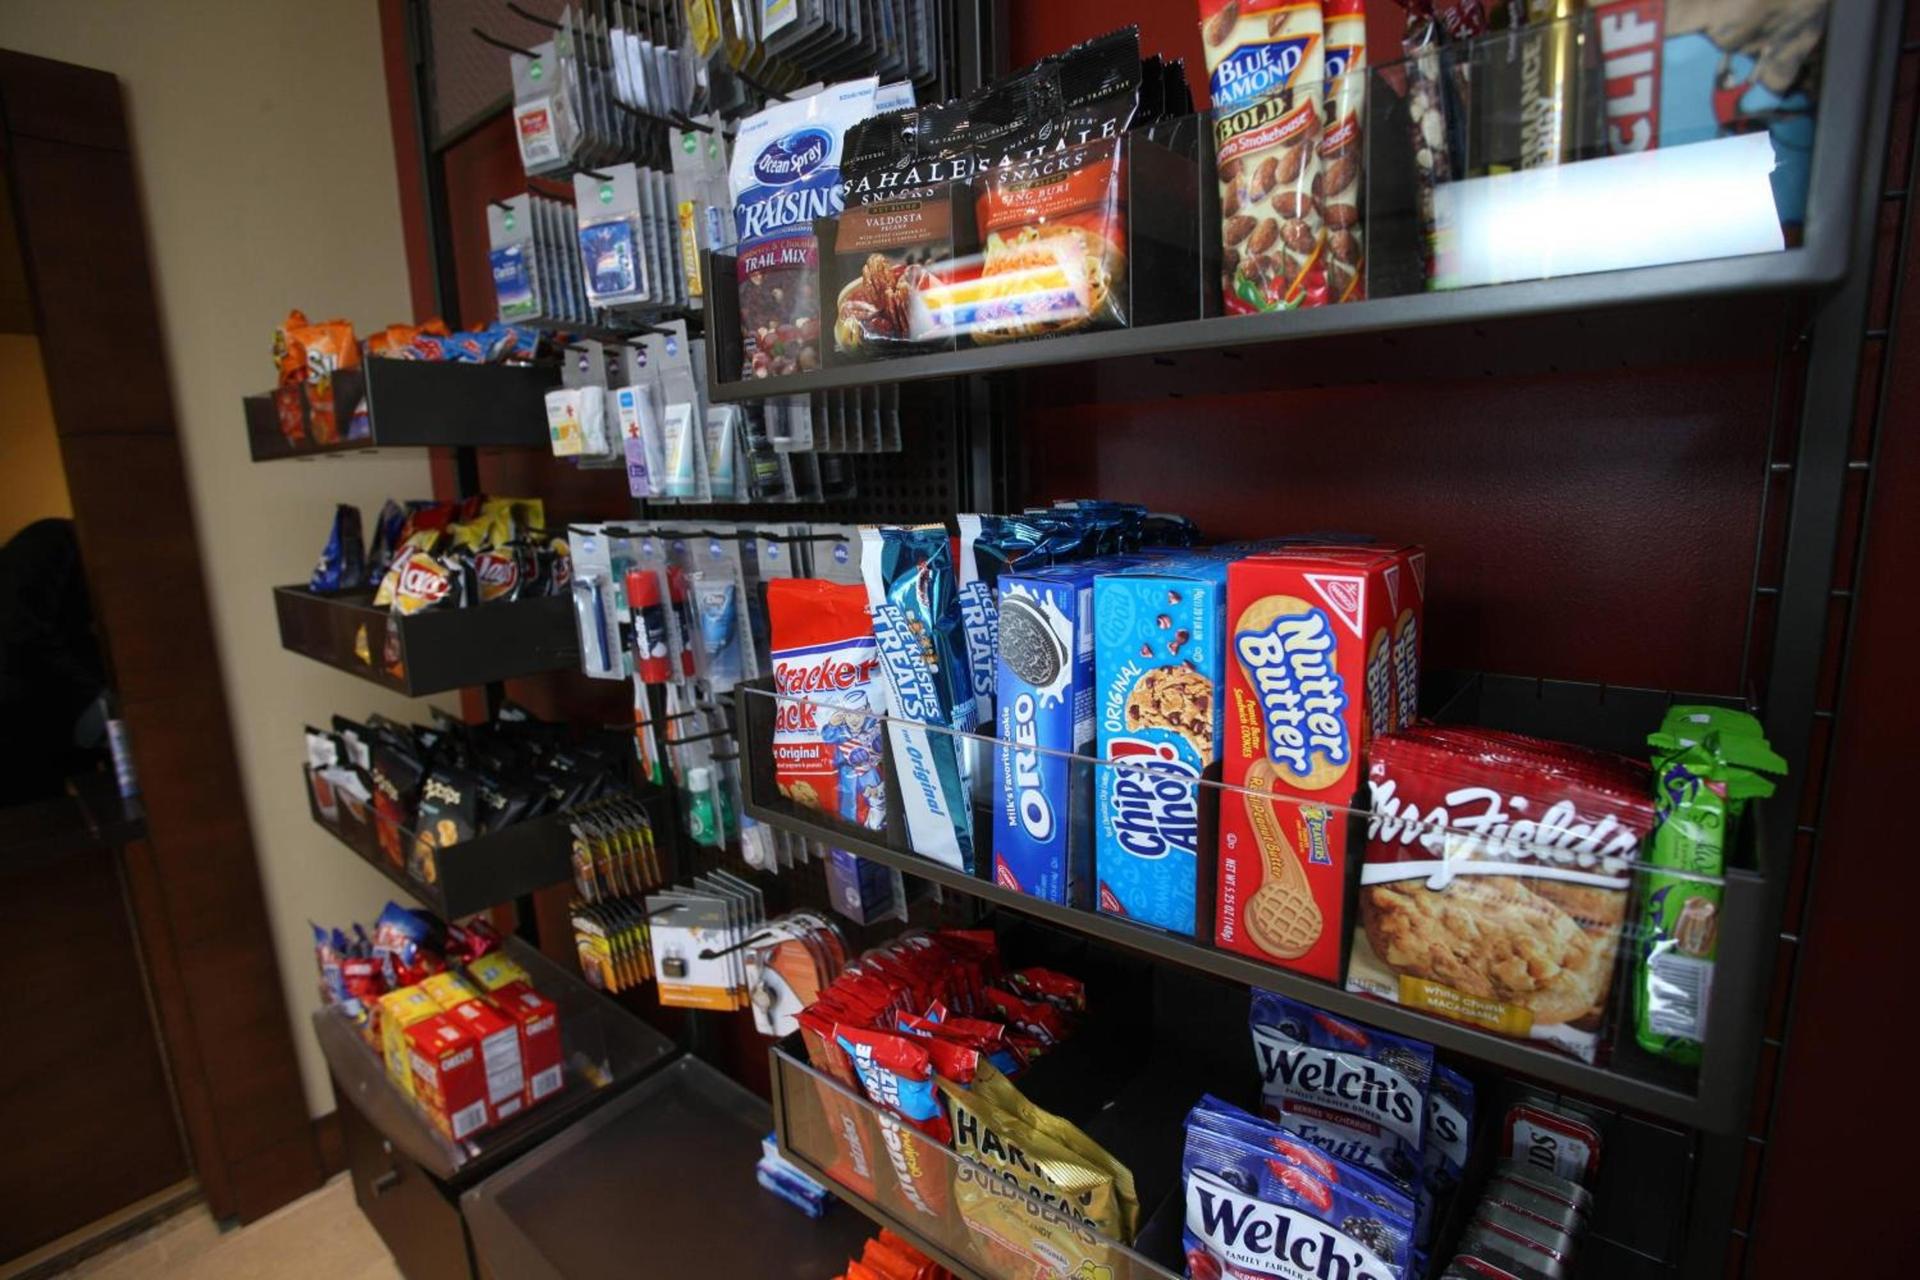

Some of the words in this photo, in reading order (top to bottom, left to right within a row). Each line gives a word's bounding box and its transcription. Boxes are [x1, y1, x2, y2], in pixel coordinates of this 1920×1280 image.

[1211, 46, 1302, 108] IAMOND
[1218, 45, 1273, 87] BLUE
[1602, 11, 1657, 156] CLIF
[1218, 98, 1285, 140] BOLD
[1239, 109, 1310, 150] Smokehouse
[759, 154, 790, 174] Ocean
[790, 139, 822, 174] Spray
[1000, 152, 1083, 184] SNACKS
[843, 159, 967, 196] SAHALE
[861, 188, 935, 206] SNACKS
[1038, 183, 1070, 199] BURI
[866, 213, 923, 228] VALDOSTA
[745, 252, 776, 274] TRAIL
[781, 248, 807, 264] MIX
[959, 583, 994, 695] TREATS
[776, 656, 881, 695] Cracker
[873, 610, 926, 722] TREATS
[884, 604, 916, 640] RICE
[904, 642, 941, 719] KRISPIES
[1104, 660, 1143, 733] ORIGINAL
[1239, 632, 1307, 771] Butter
[1277, 614, 1344, 760] Nutter
[776, 696, 819, 735] ack
[779, 745, 819, 762] Original
[1015, 692, 1051, 839] OREO
[906, 745, 946, 817] Original
[1114, 760, 1167, 857] Chips
[1311, 819, 1327, 860] PLANTERS
[1424, 984, 1460, 1003] white
[1427, 997, 1500, 1025] MACADAMIA
[1257, 1042, 1414, 1124] Welch's
[1298, 1124, 1373, 1165] Fruit
[1225, 1250, 1261, 1267] FAMILY
